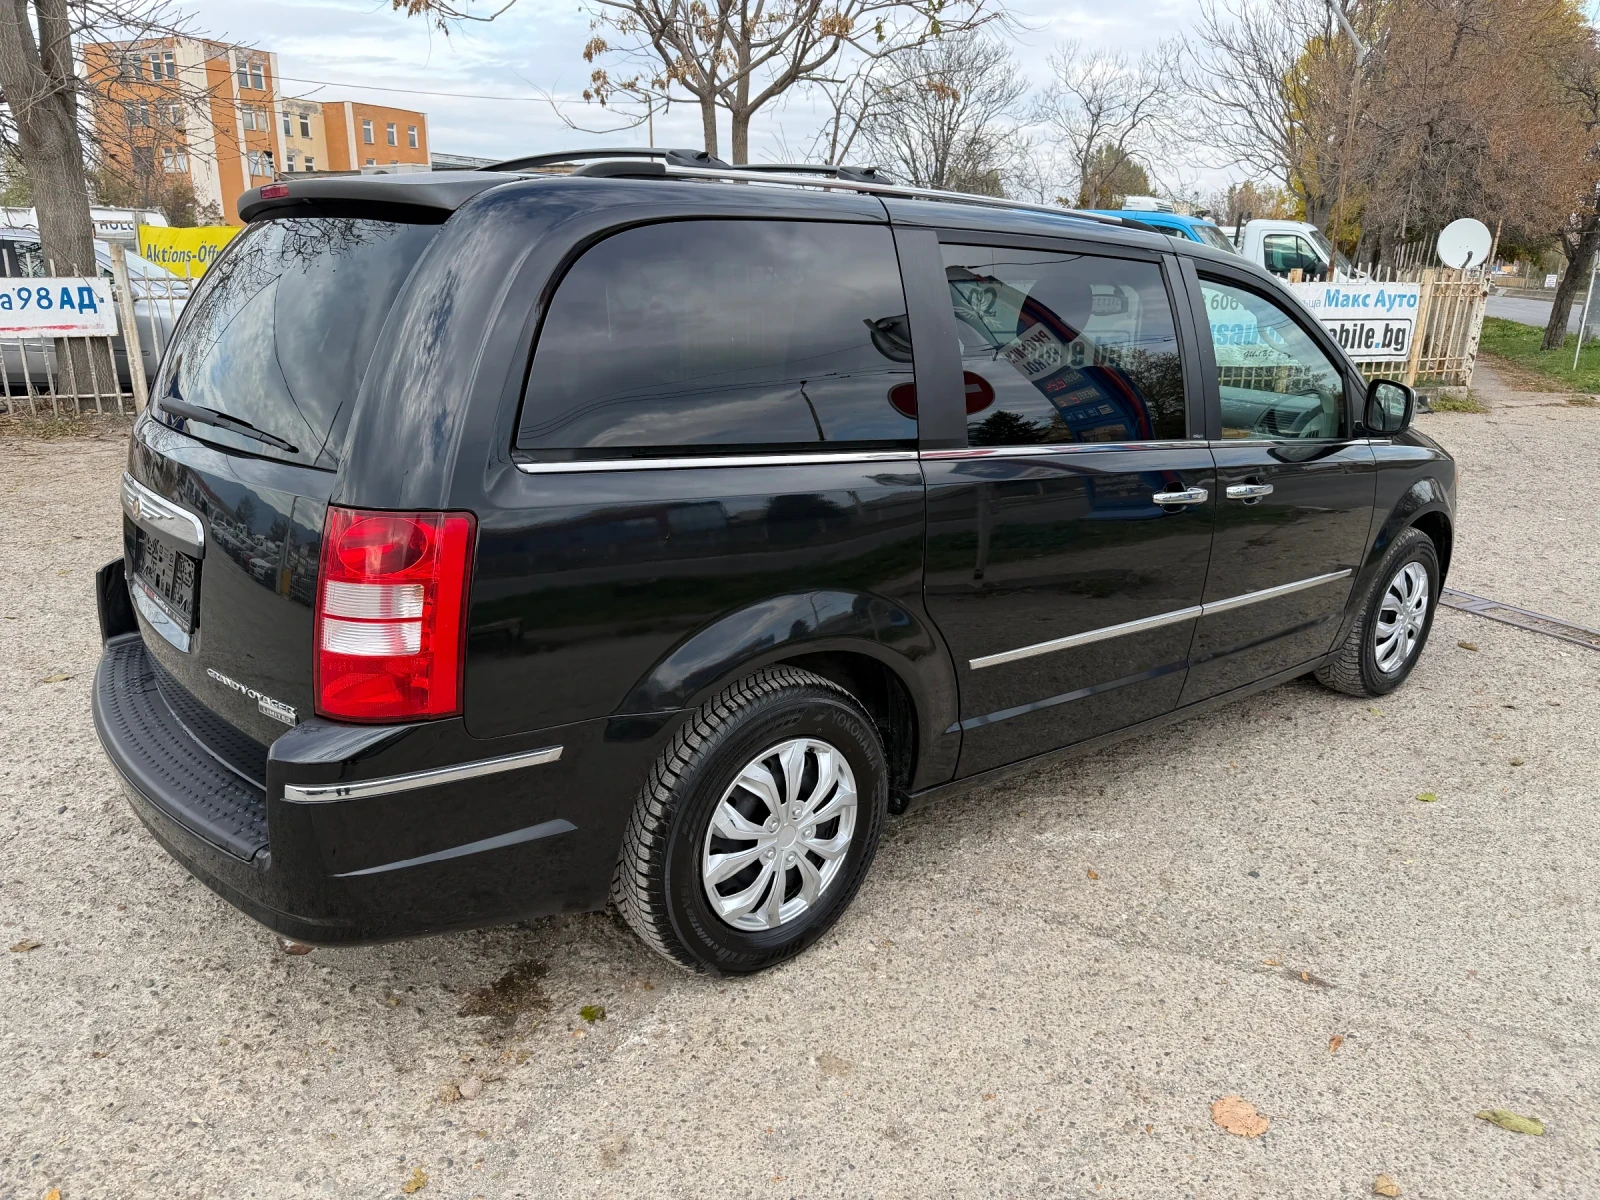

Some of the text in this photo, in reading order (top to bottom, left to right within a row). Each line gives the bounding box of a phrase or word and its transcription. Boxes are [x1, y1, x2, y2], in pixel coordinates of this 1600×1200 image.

[1323, 288, 1371, 309] Макс
[1373, 288, 1418, 313] Ауто
[262, 706, 291, 723] LIMITED
[832, 709, 879, 771] YOKOHAMA
